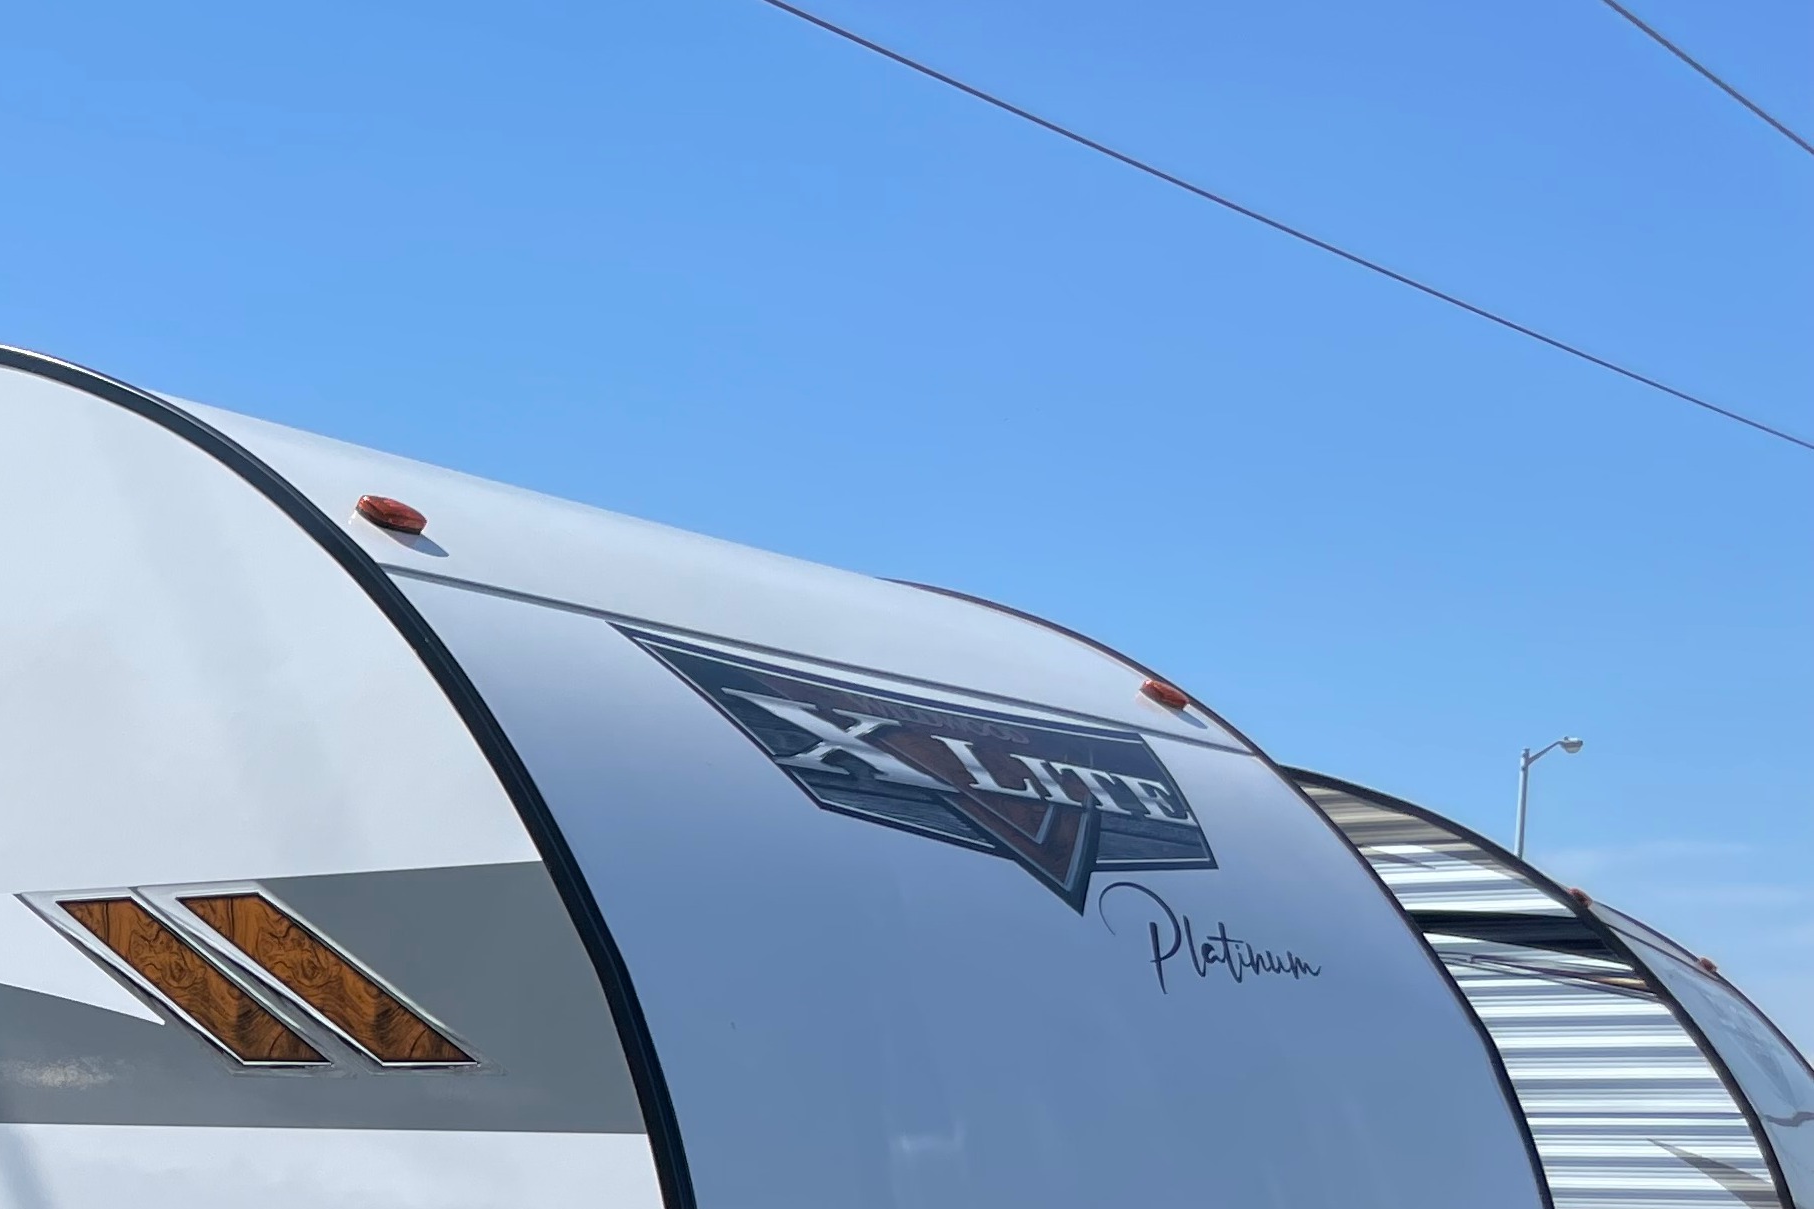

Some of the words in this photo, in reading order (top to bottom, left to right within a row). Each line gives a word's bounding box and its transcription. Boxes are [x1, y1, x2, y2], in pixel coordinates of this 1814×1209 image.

[720, 686, 960, 793] X
[930, 734, 1196, 827] LITE
[1098, 881, 1322, 995] Platinum
